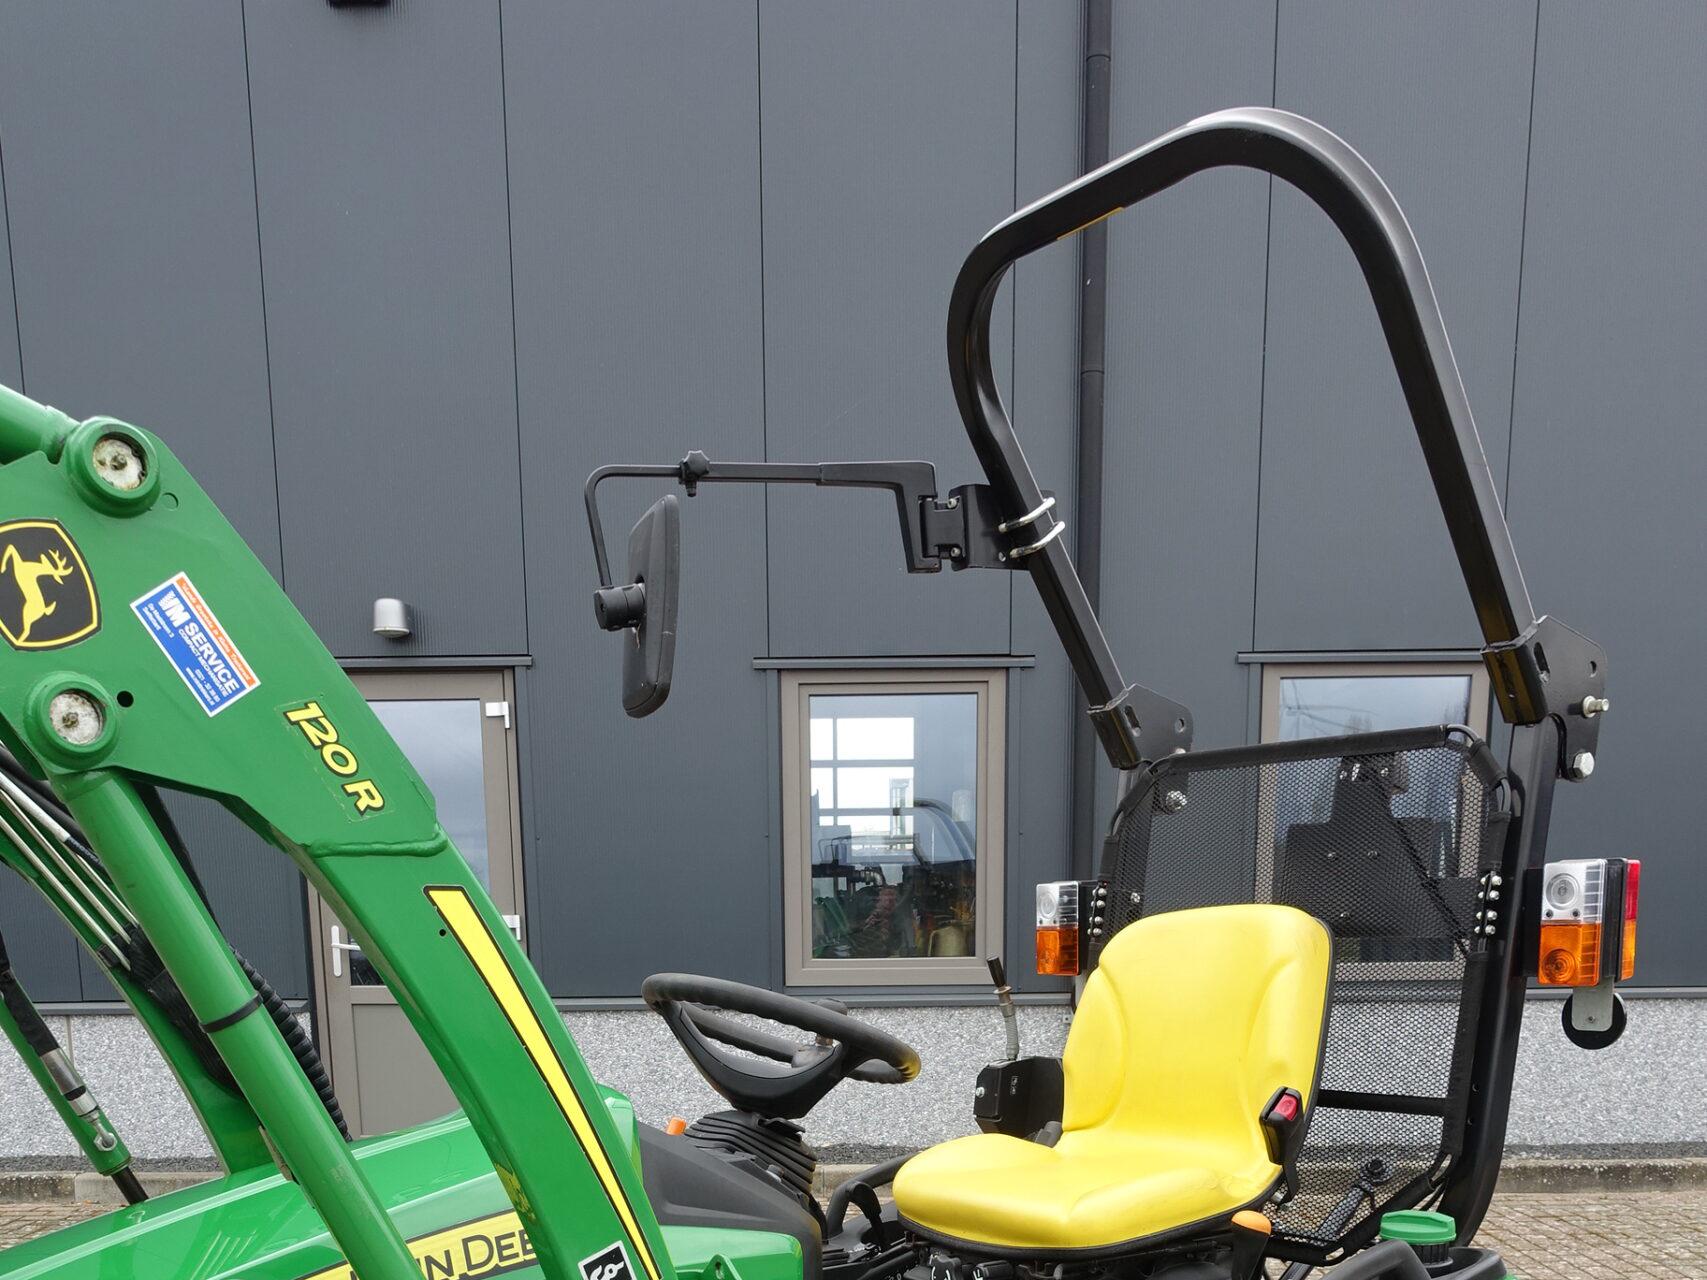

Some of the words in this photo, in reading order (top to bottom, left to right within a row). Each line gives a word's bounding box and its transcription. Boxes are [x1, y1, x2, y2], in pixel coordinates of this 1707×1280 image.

[182, 620, 240, 694] SERVICE
[283, 701, 359, 778] 120
[341, 779, 385, 816] R
